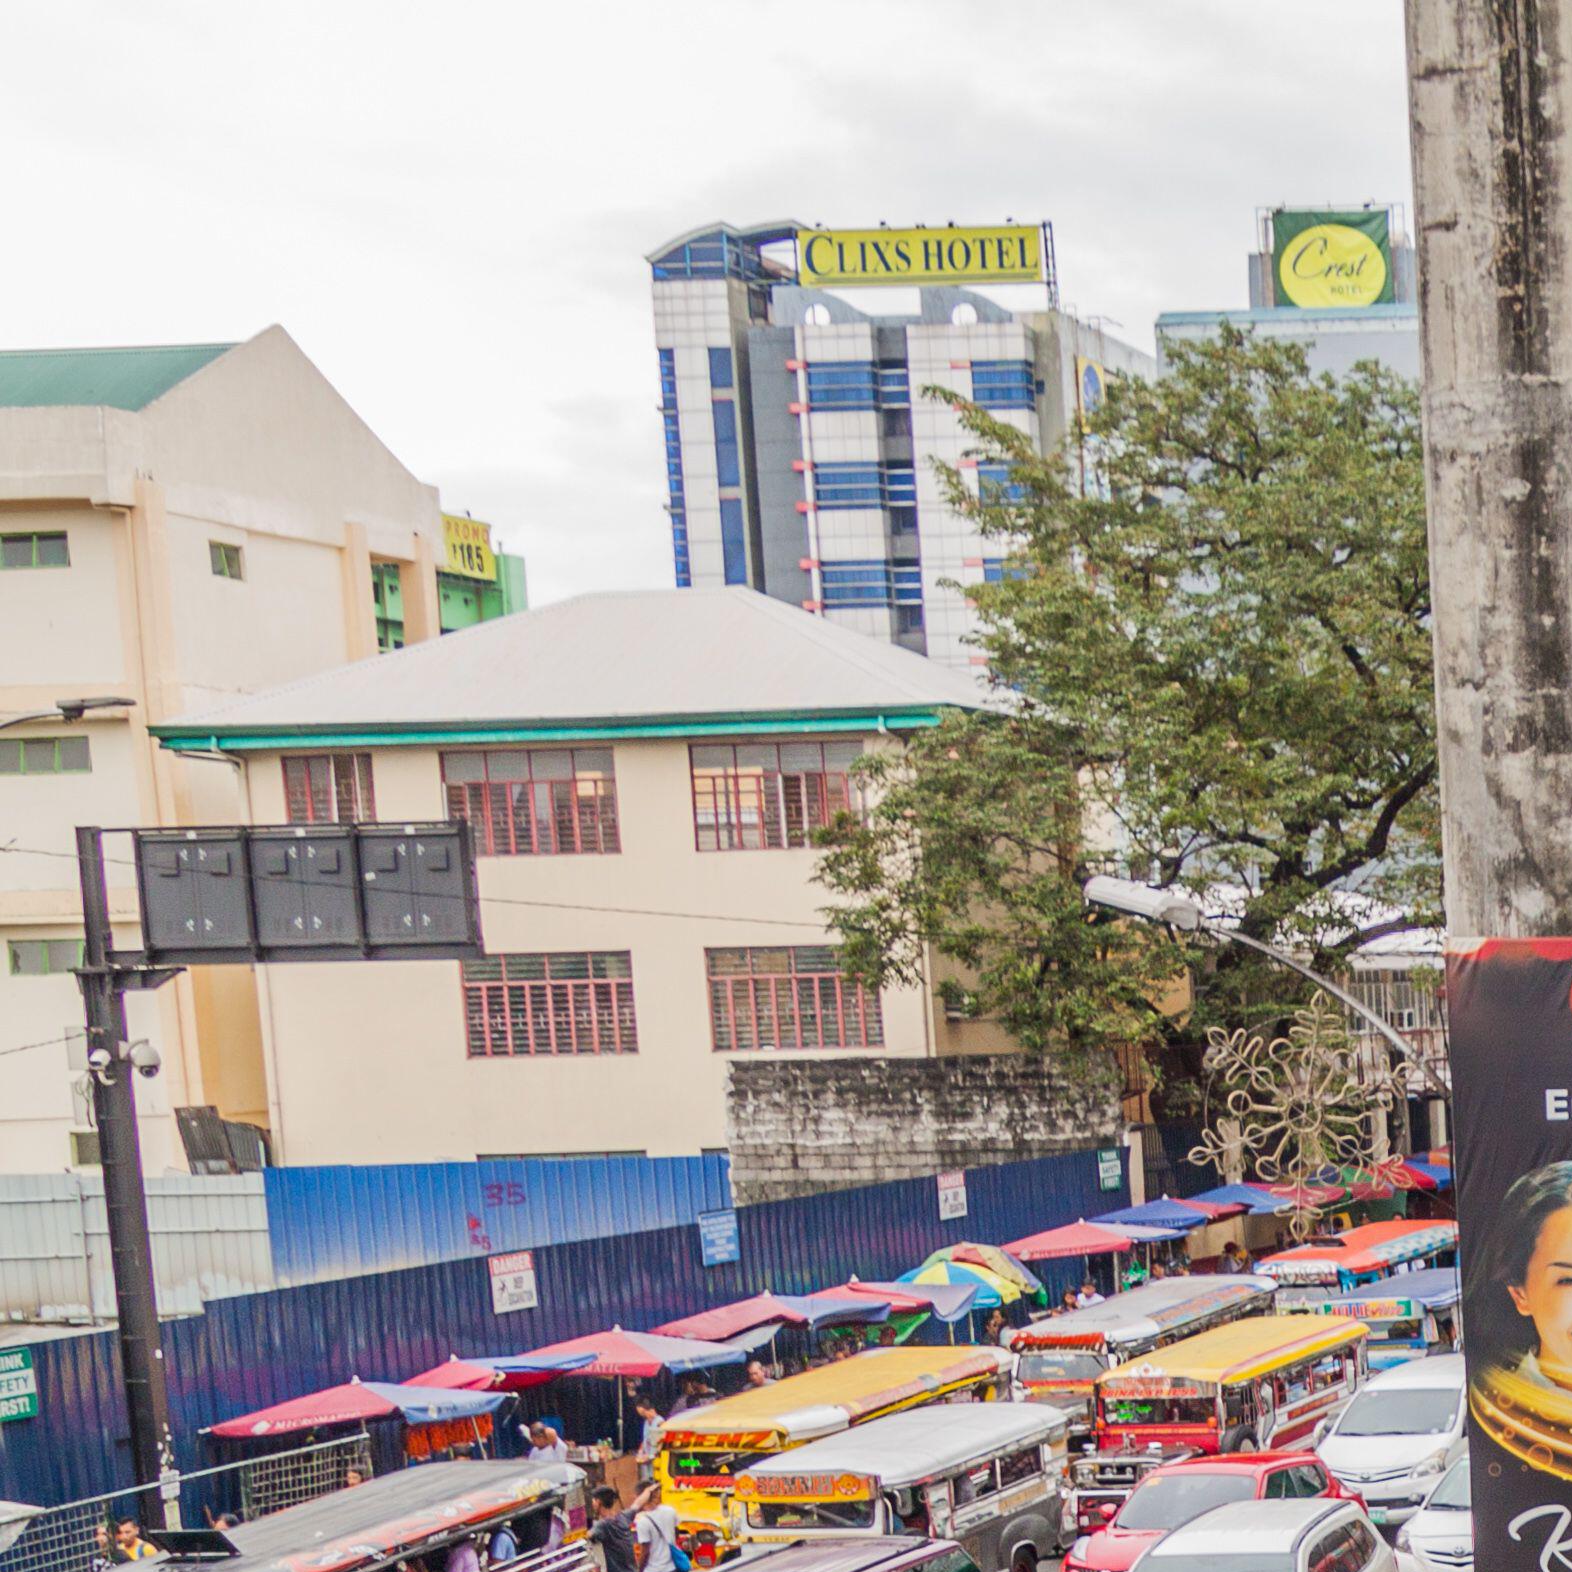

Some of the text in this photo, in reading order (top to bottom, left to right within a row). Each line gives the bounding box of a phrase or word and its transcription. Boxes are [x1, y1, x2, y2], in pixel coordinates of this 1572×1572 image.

[805, 235, 1038, 276] CLIXS HOTEL
[1293, 236, 1368, 279] Crest
[1330, 285, 1363, 295] HOTEL
